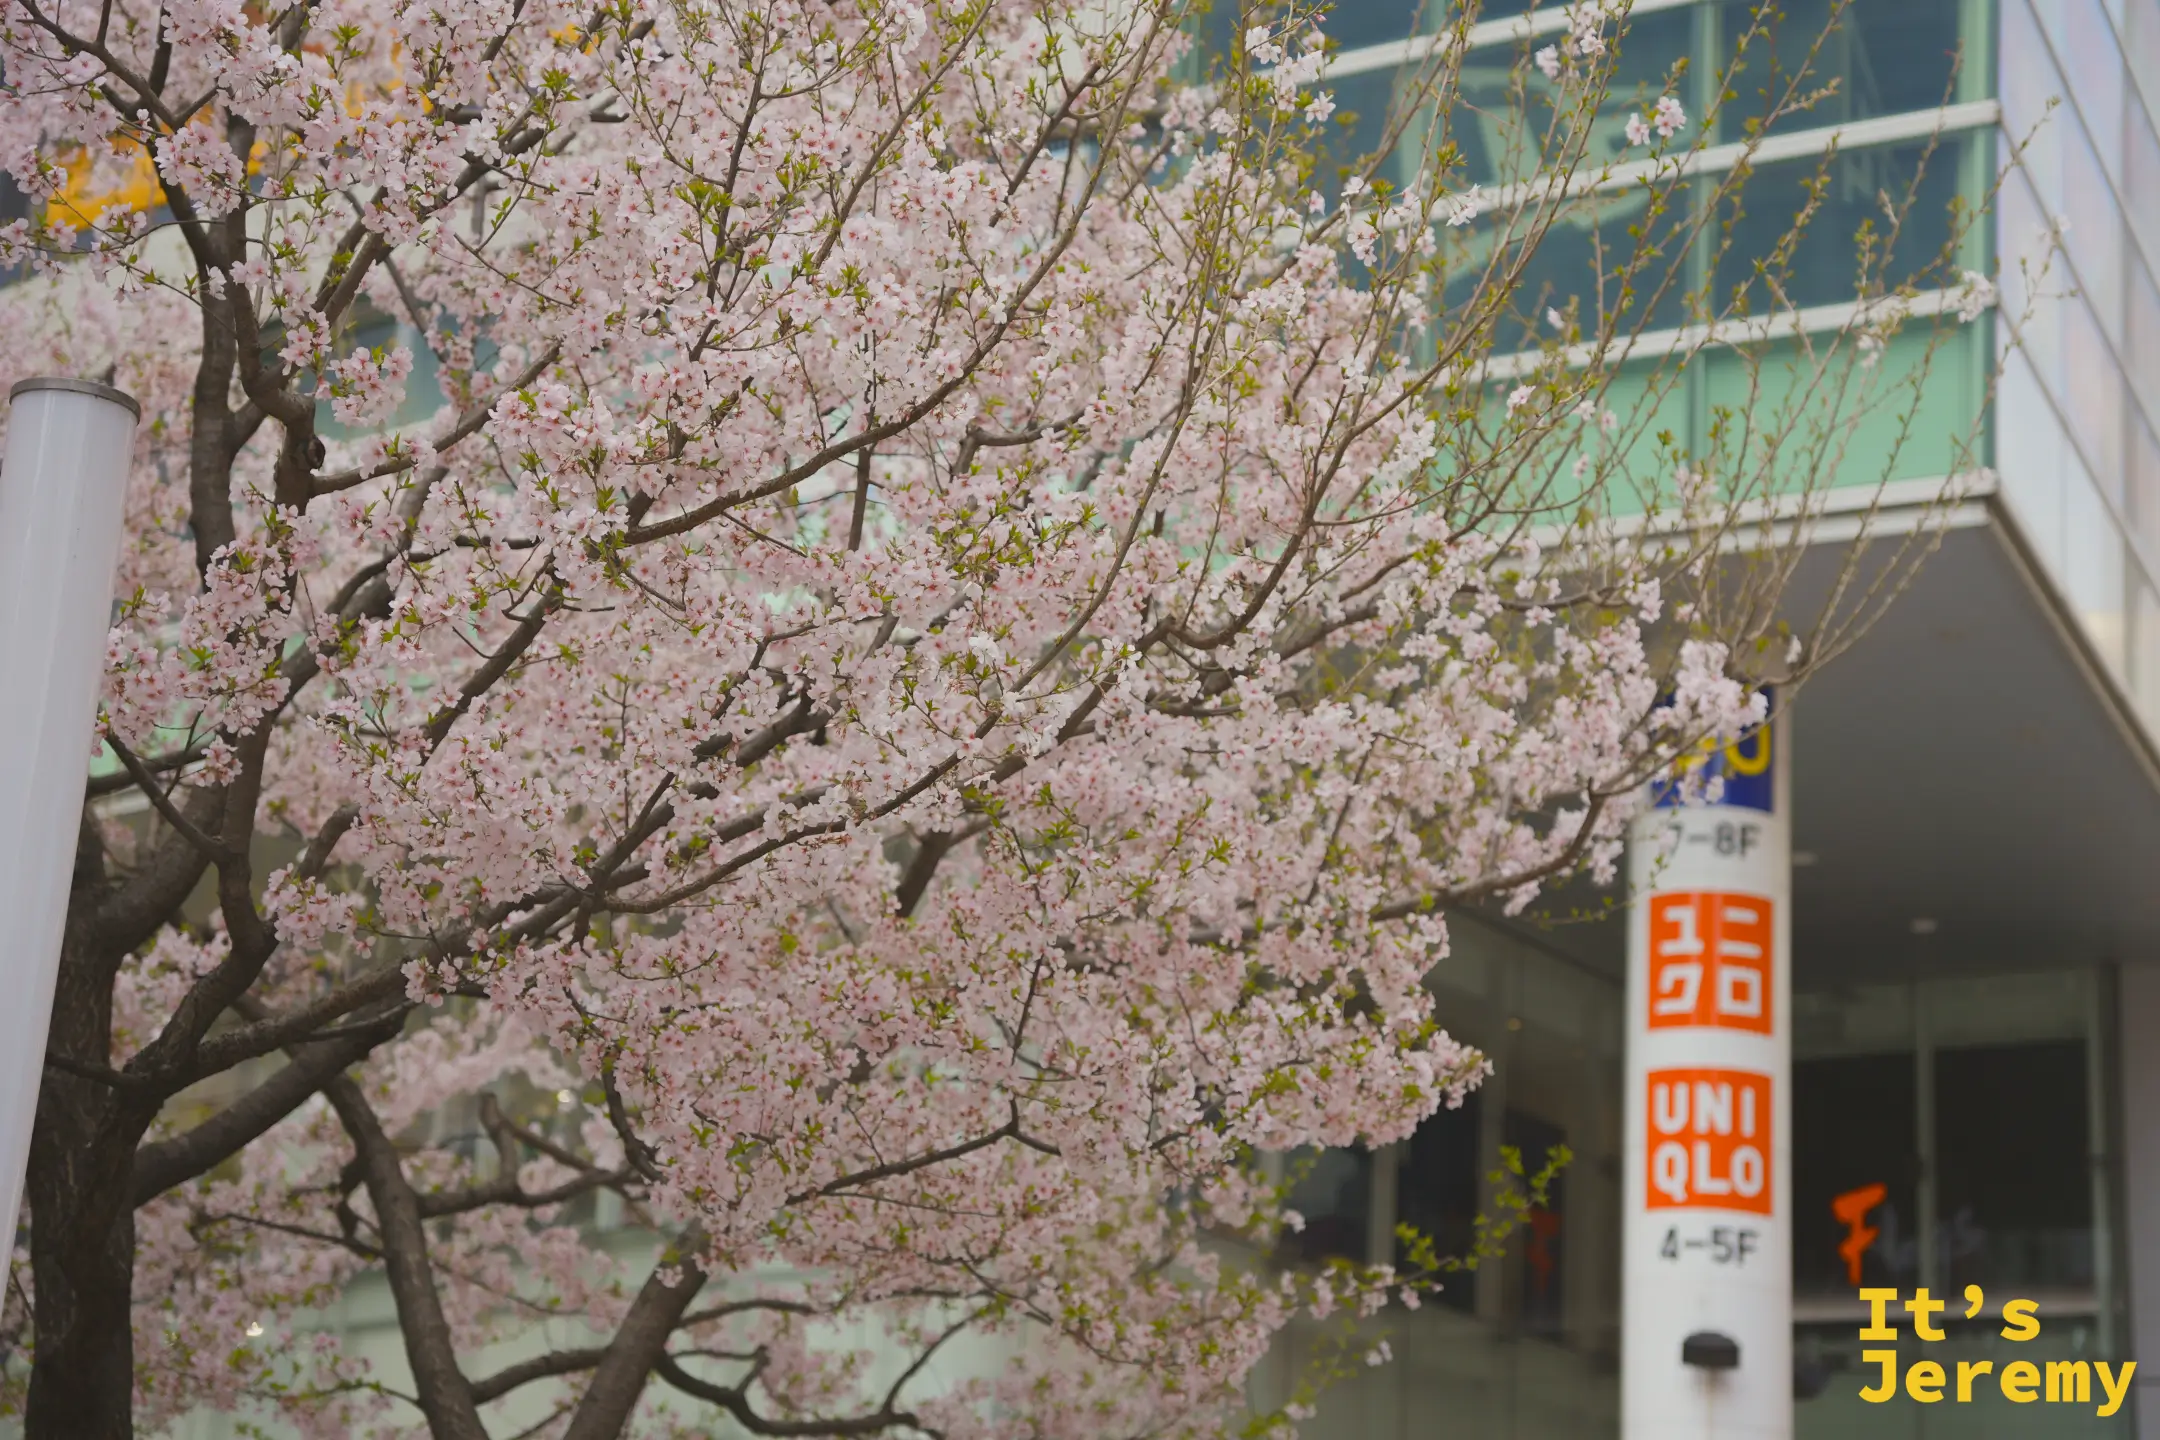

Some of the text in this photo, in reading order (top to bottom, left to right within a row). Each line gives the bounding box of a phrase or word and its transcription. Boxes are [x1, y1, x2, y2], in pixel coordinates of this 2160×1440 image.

[1658, 904, 1763, 960] ユニ
[1655, 962, 1763, 1018] クロ
[1653, 1080, 1757, 1138] UNI
[1652, 1139, 1764, 1203] QLO
[1660, 1226, 1759, 1266] 4-5F
